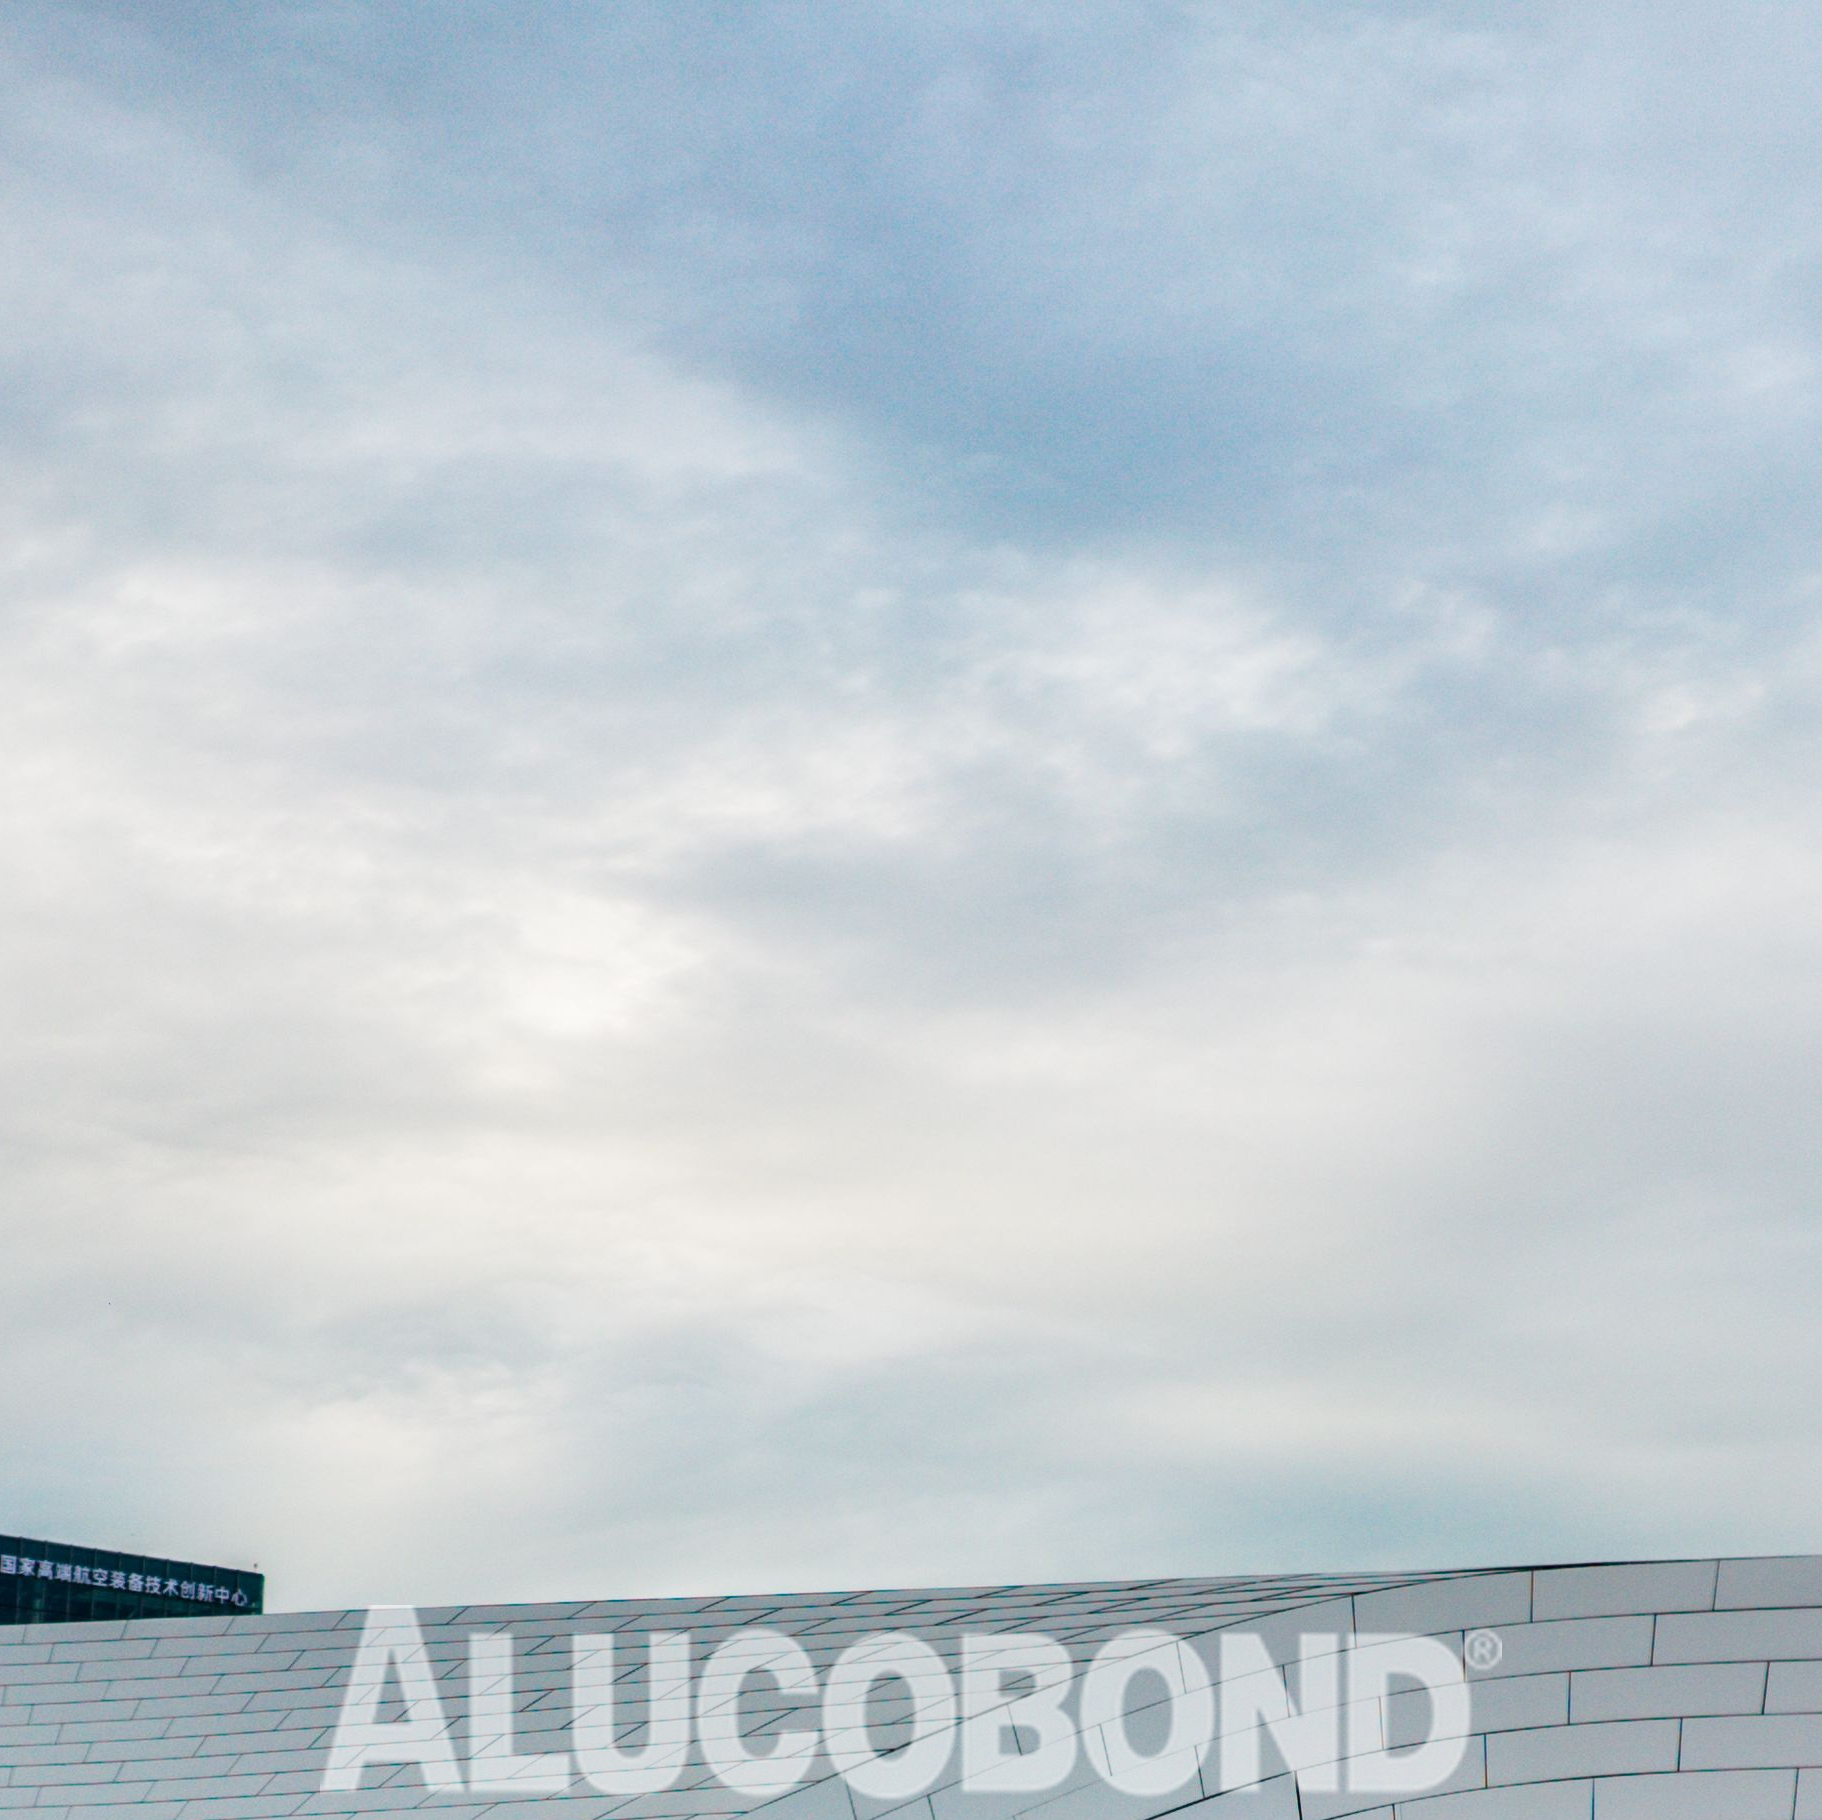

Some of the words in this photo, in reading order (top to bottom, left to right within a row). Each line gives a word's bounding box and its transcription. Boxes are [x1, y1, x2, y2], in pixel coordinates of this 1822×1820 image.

[0, 1554, 248, 1607] 国家高端航空装备技术创新中心
